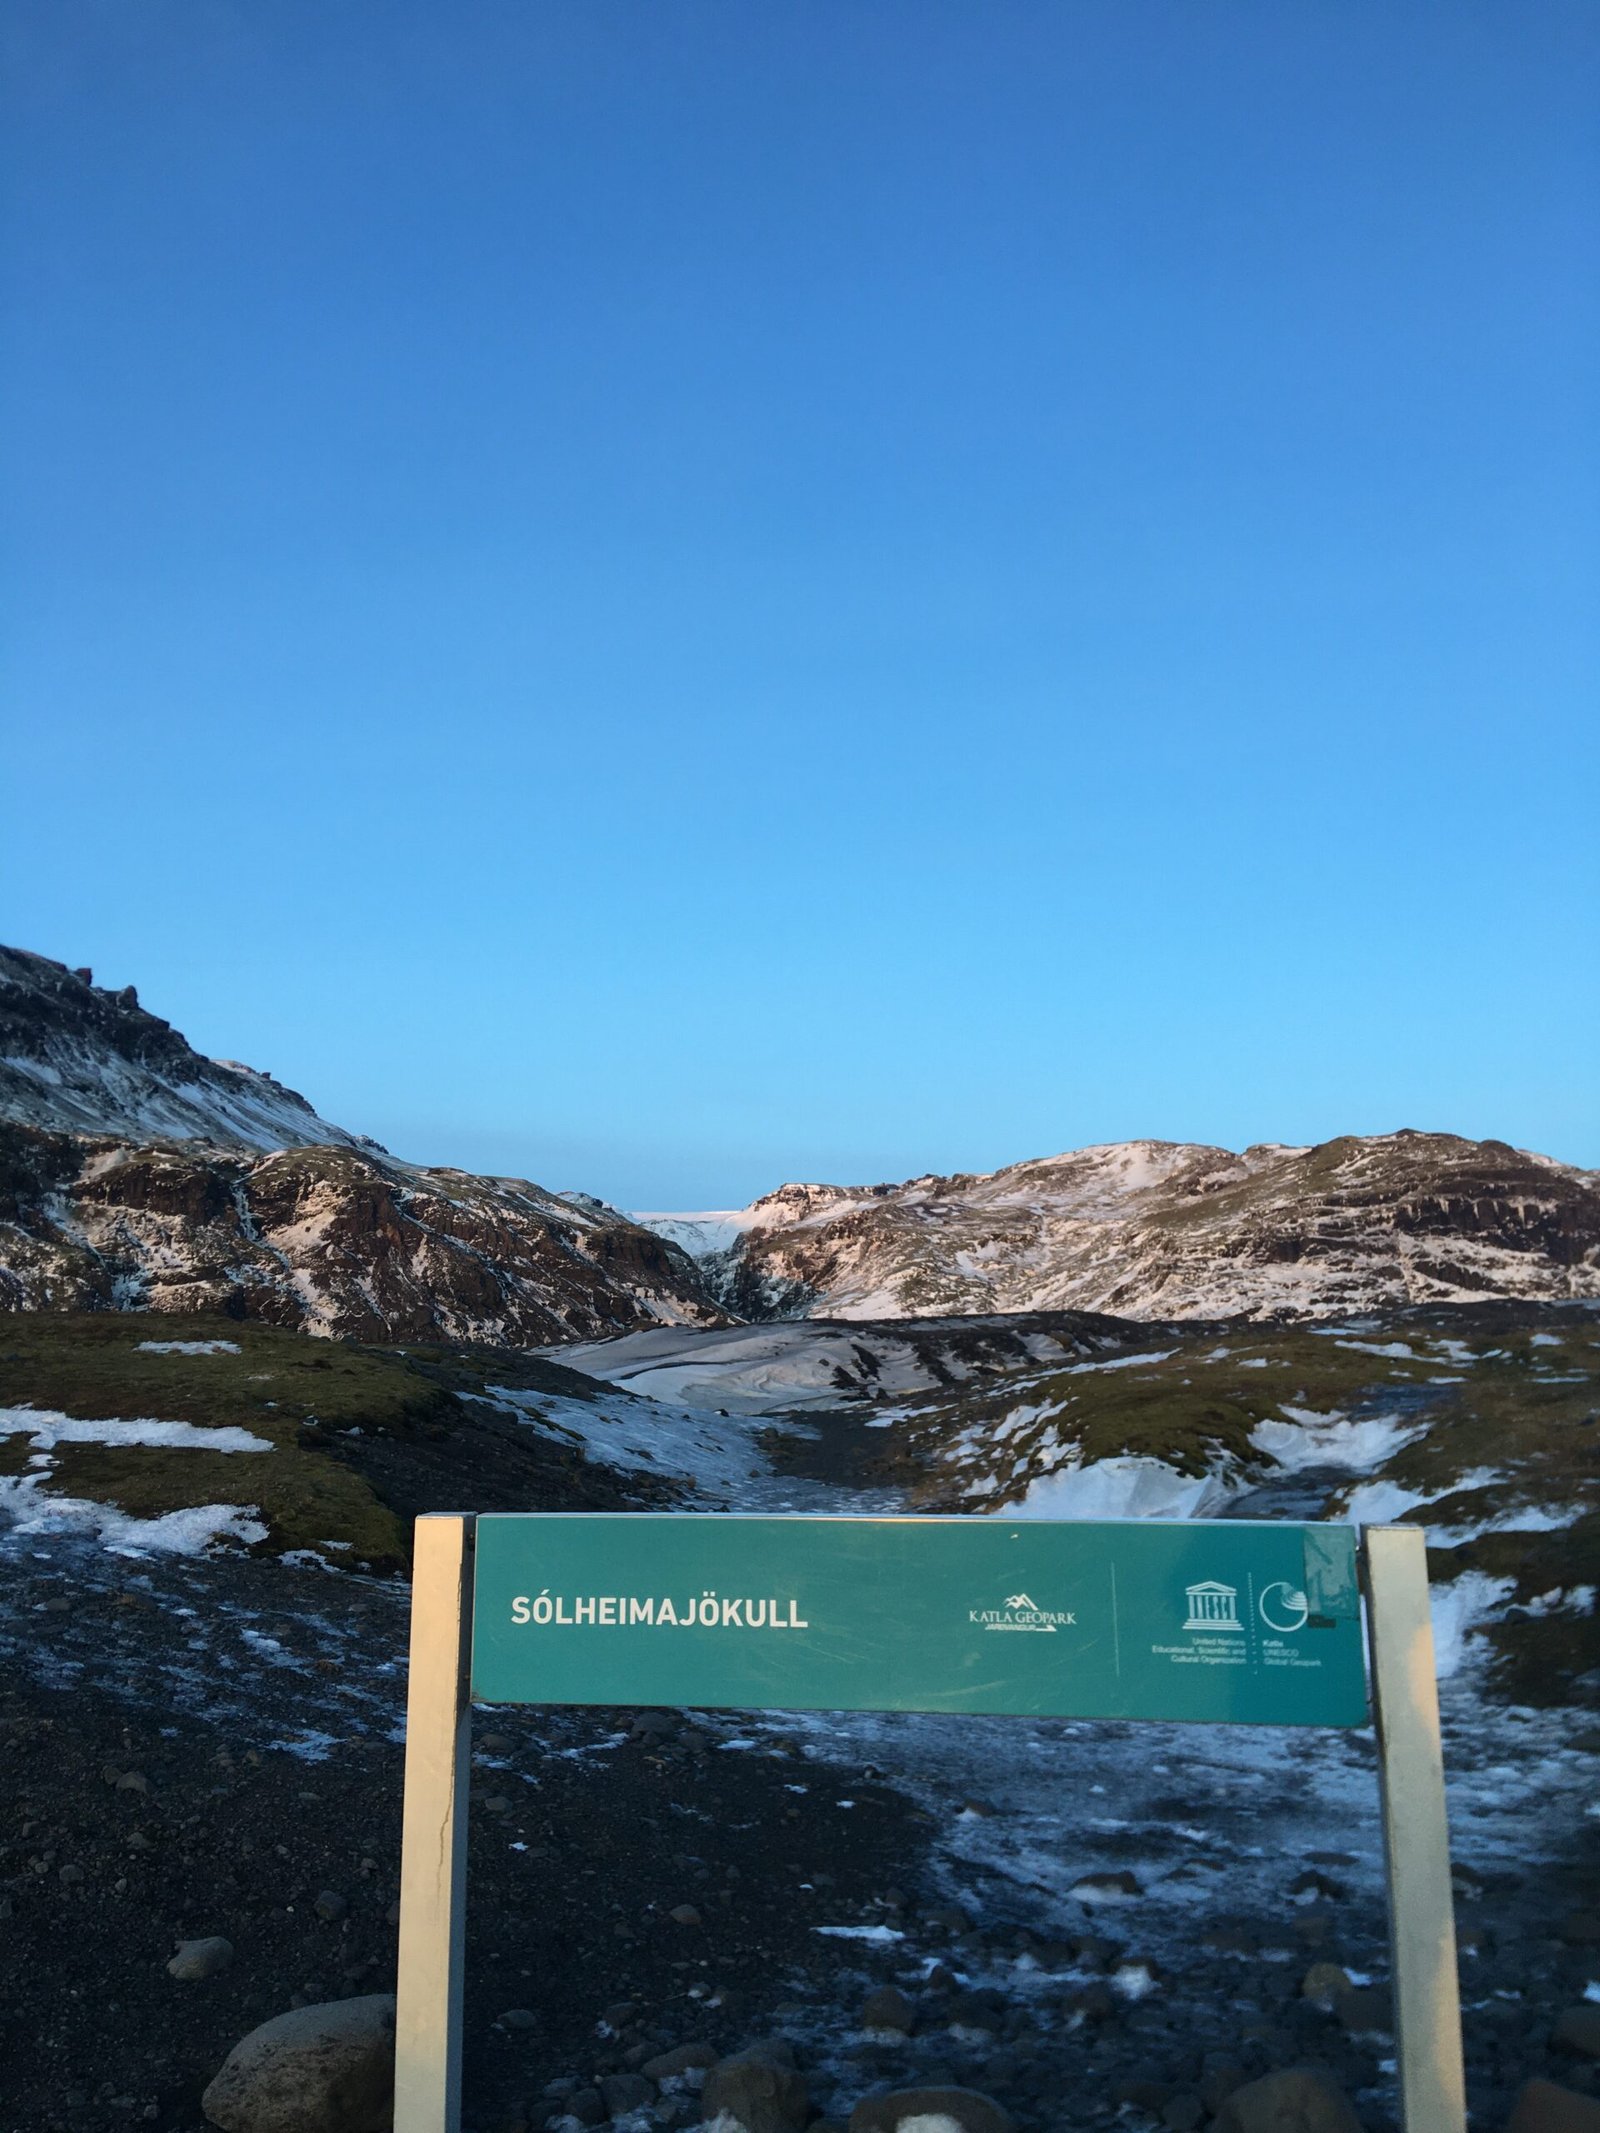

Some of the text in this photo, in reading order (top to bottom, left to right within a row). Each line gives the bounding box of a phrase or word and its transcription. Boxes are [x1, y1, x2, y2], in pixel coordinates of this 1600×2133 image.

[510, 1588, 808, 1627] SÓLHEIMAJÖKULL
[969, 1610, 1077, 1624] KATLA GEOPARK
